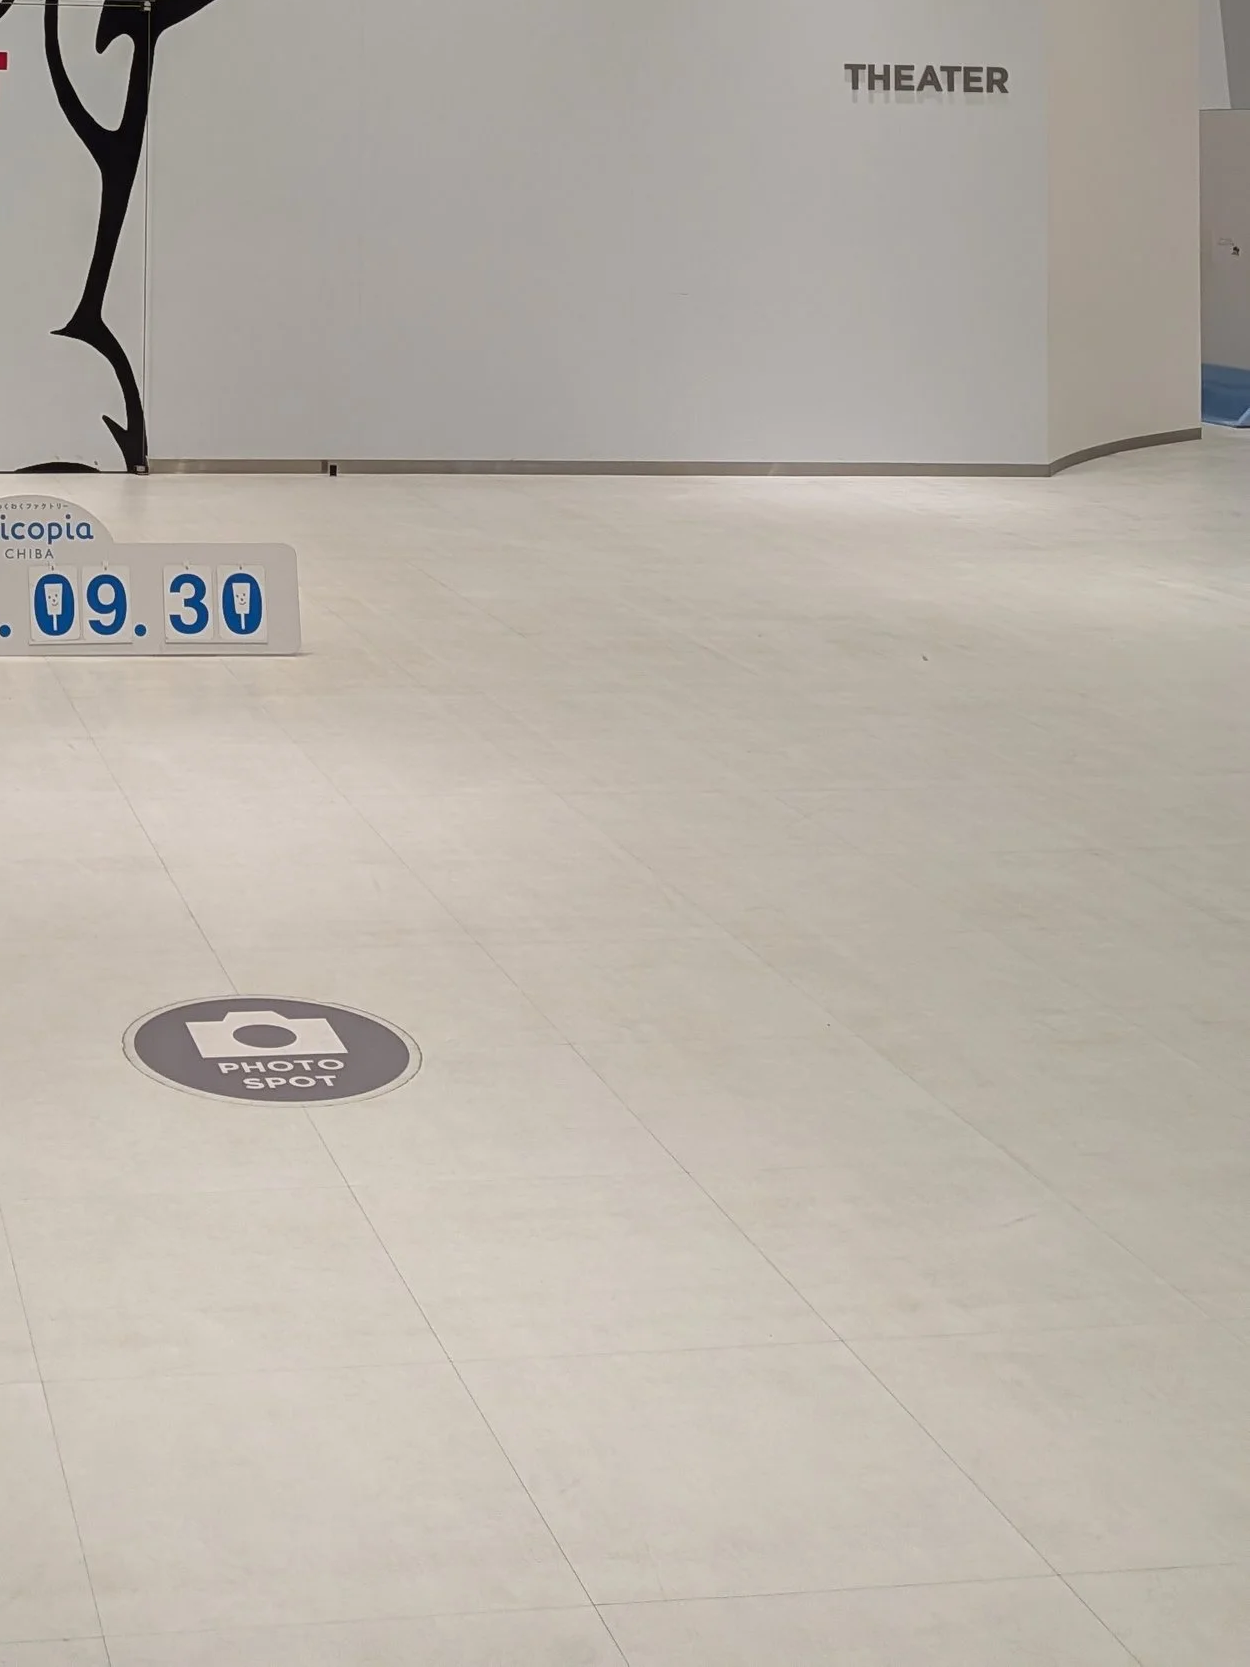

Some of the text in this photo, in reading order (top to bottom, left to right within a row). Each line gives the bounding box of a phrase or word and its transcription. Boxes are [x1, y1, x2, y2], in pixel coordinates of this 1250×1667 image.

[844, 64, 1009, 93] THEATER
[4, 548, 54, 559] CHIBA
[217, 1059, 345, 1074] PHOTO
[242, 1075, 337, 1090] SPOT
